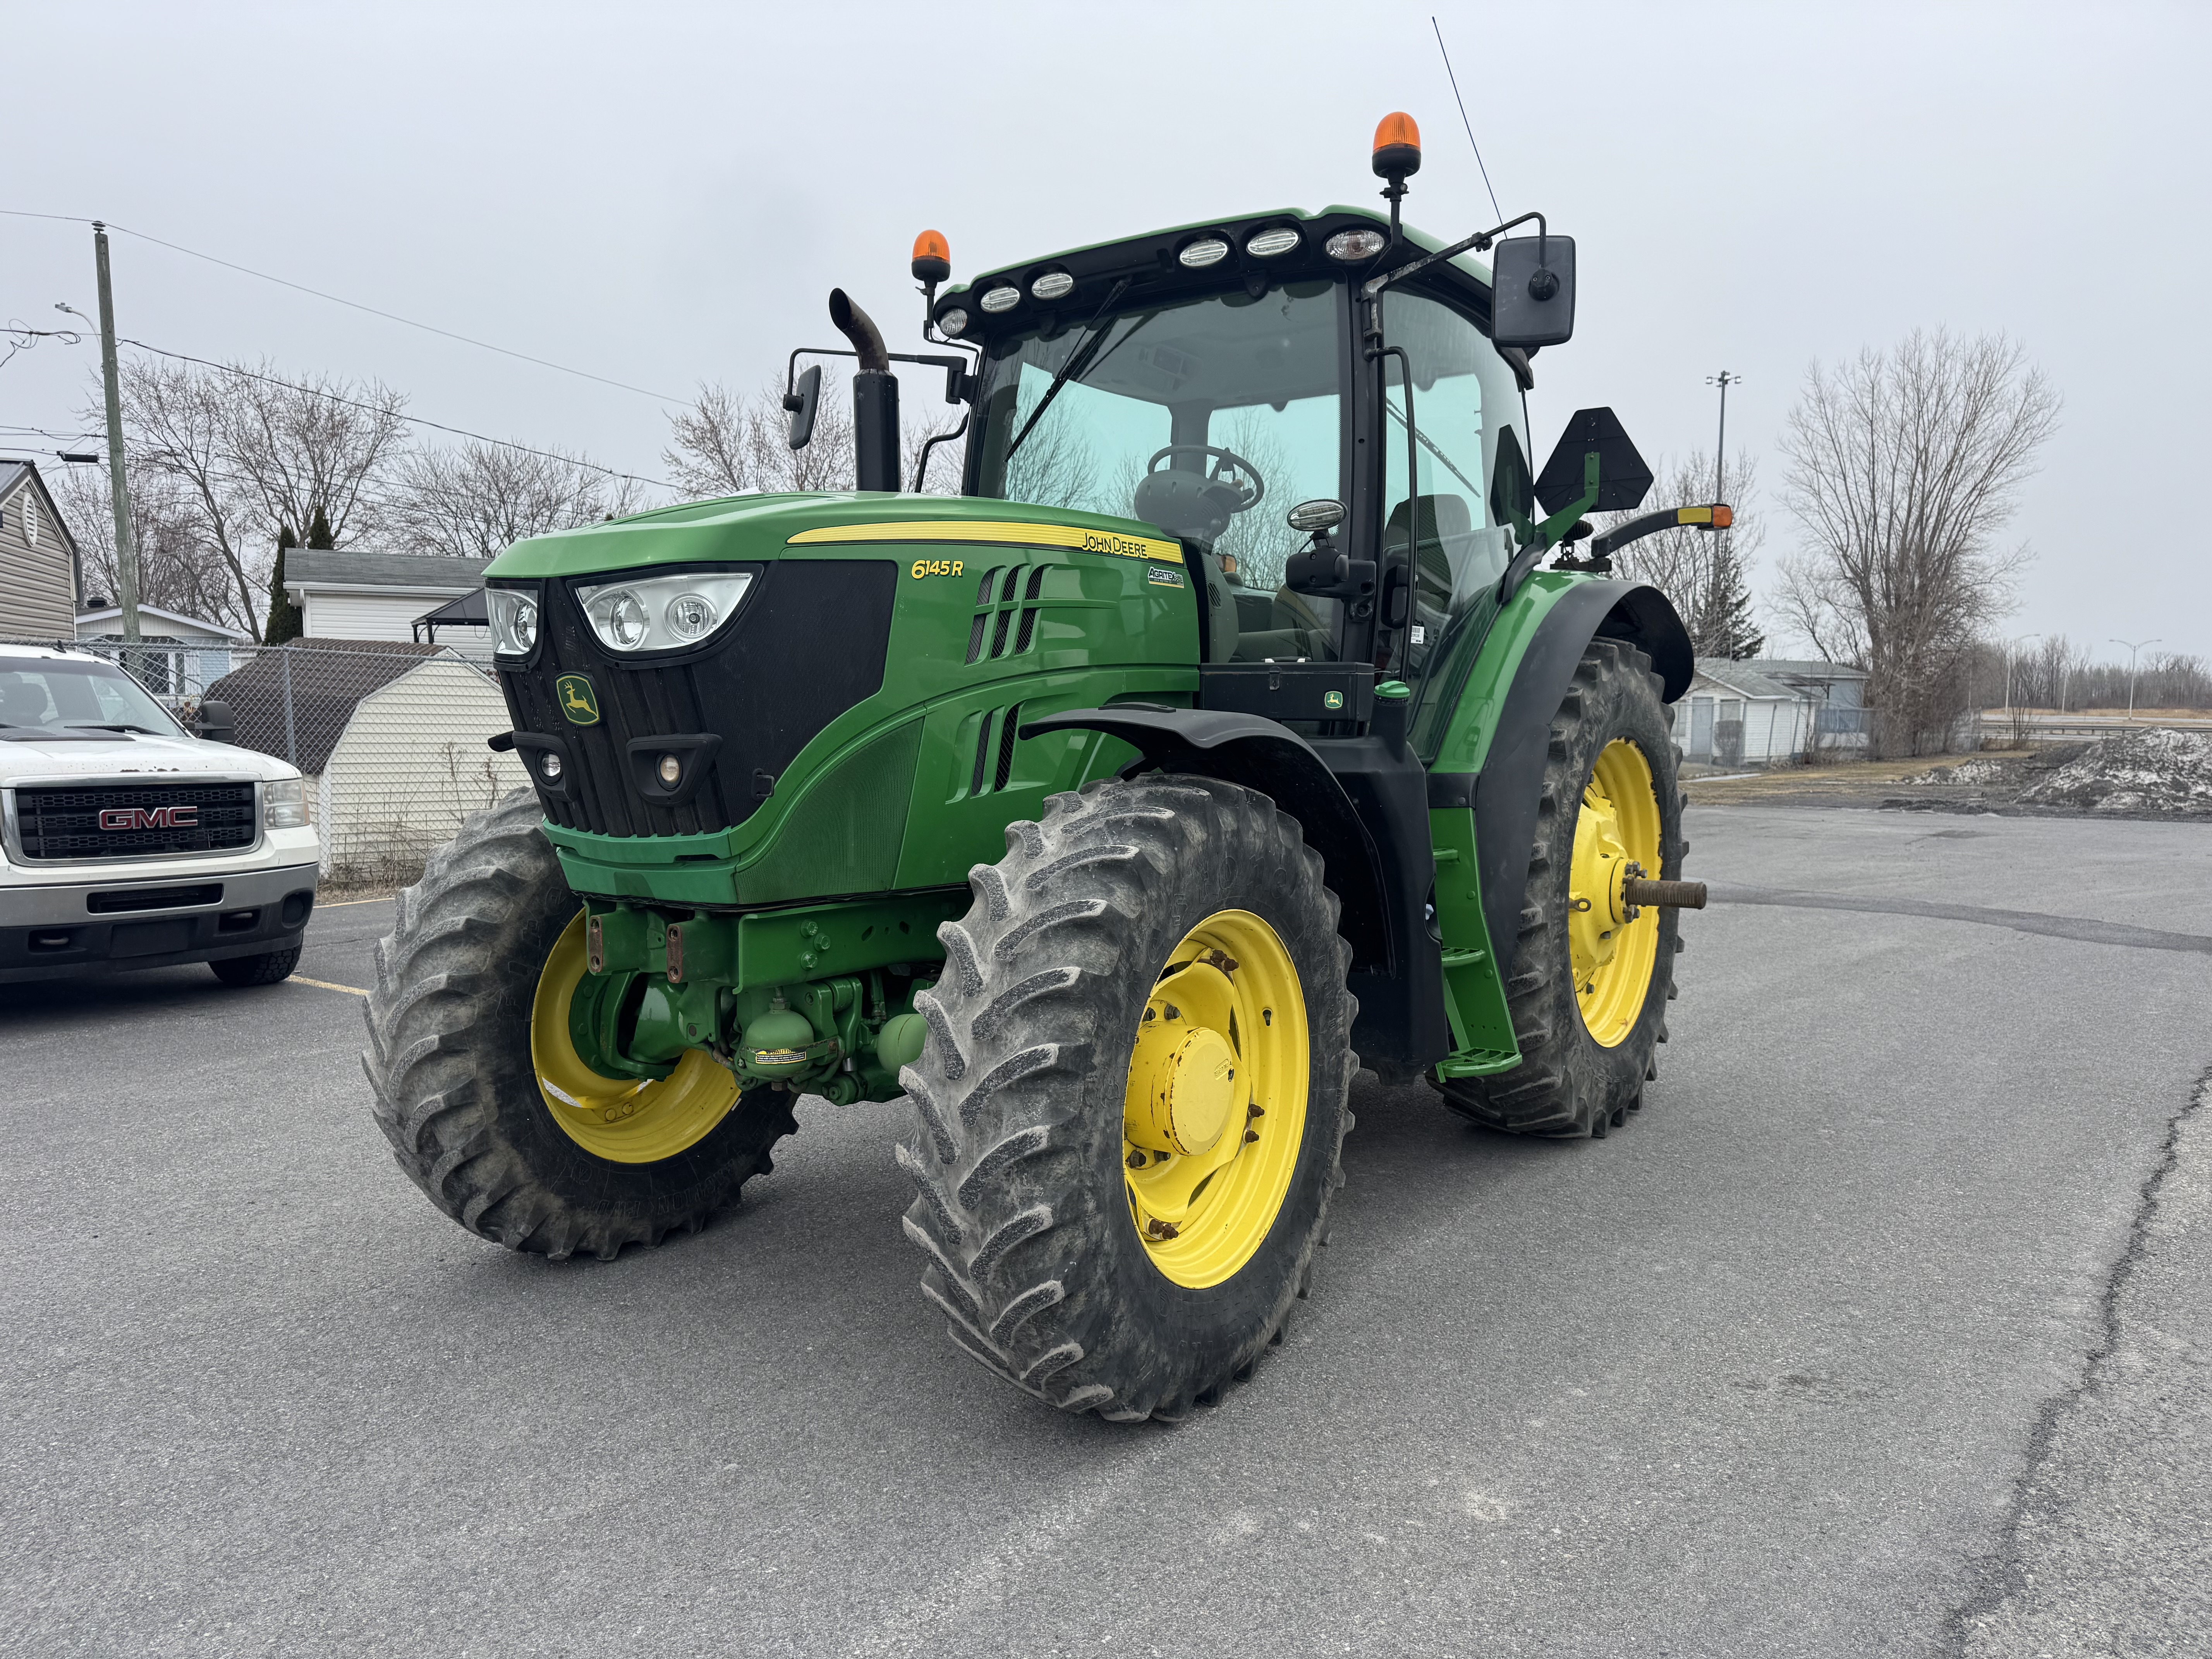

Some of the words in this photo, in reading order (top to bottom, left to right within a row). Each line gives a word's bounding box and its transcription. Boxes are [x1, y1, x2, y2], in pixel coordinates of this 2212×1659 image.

[1082, 532, 1112, 551] JOHN
[1112, 536, 1148, 557] DEERE
[1148, 568, 1176, 580] AGRITEX
[99, 805, 198, 830] GMC
